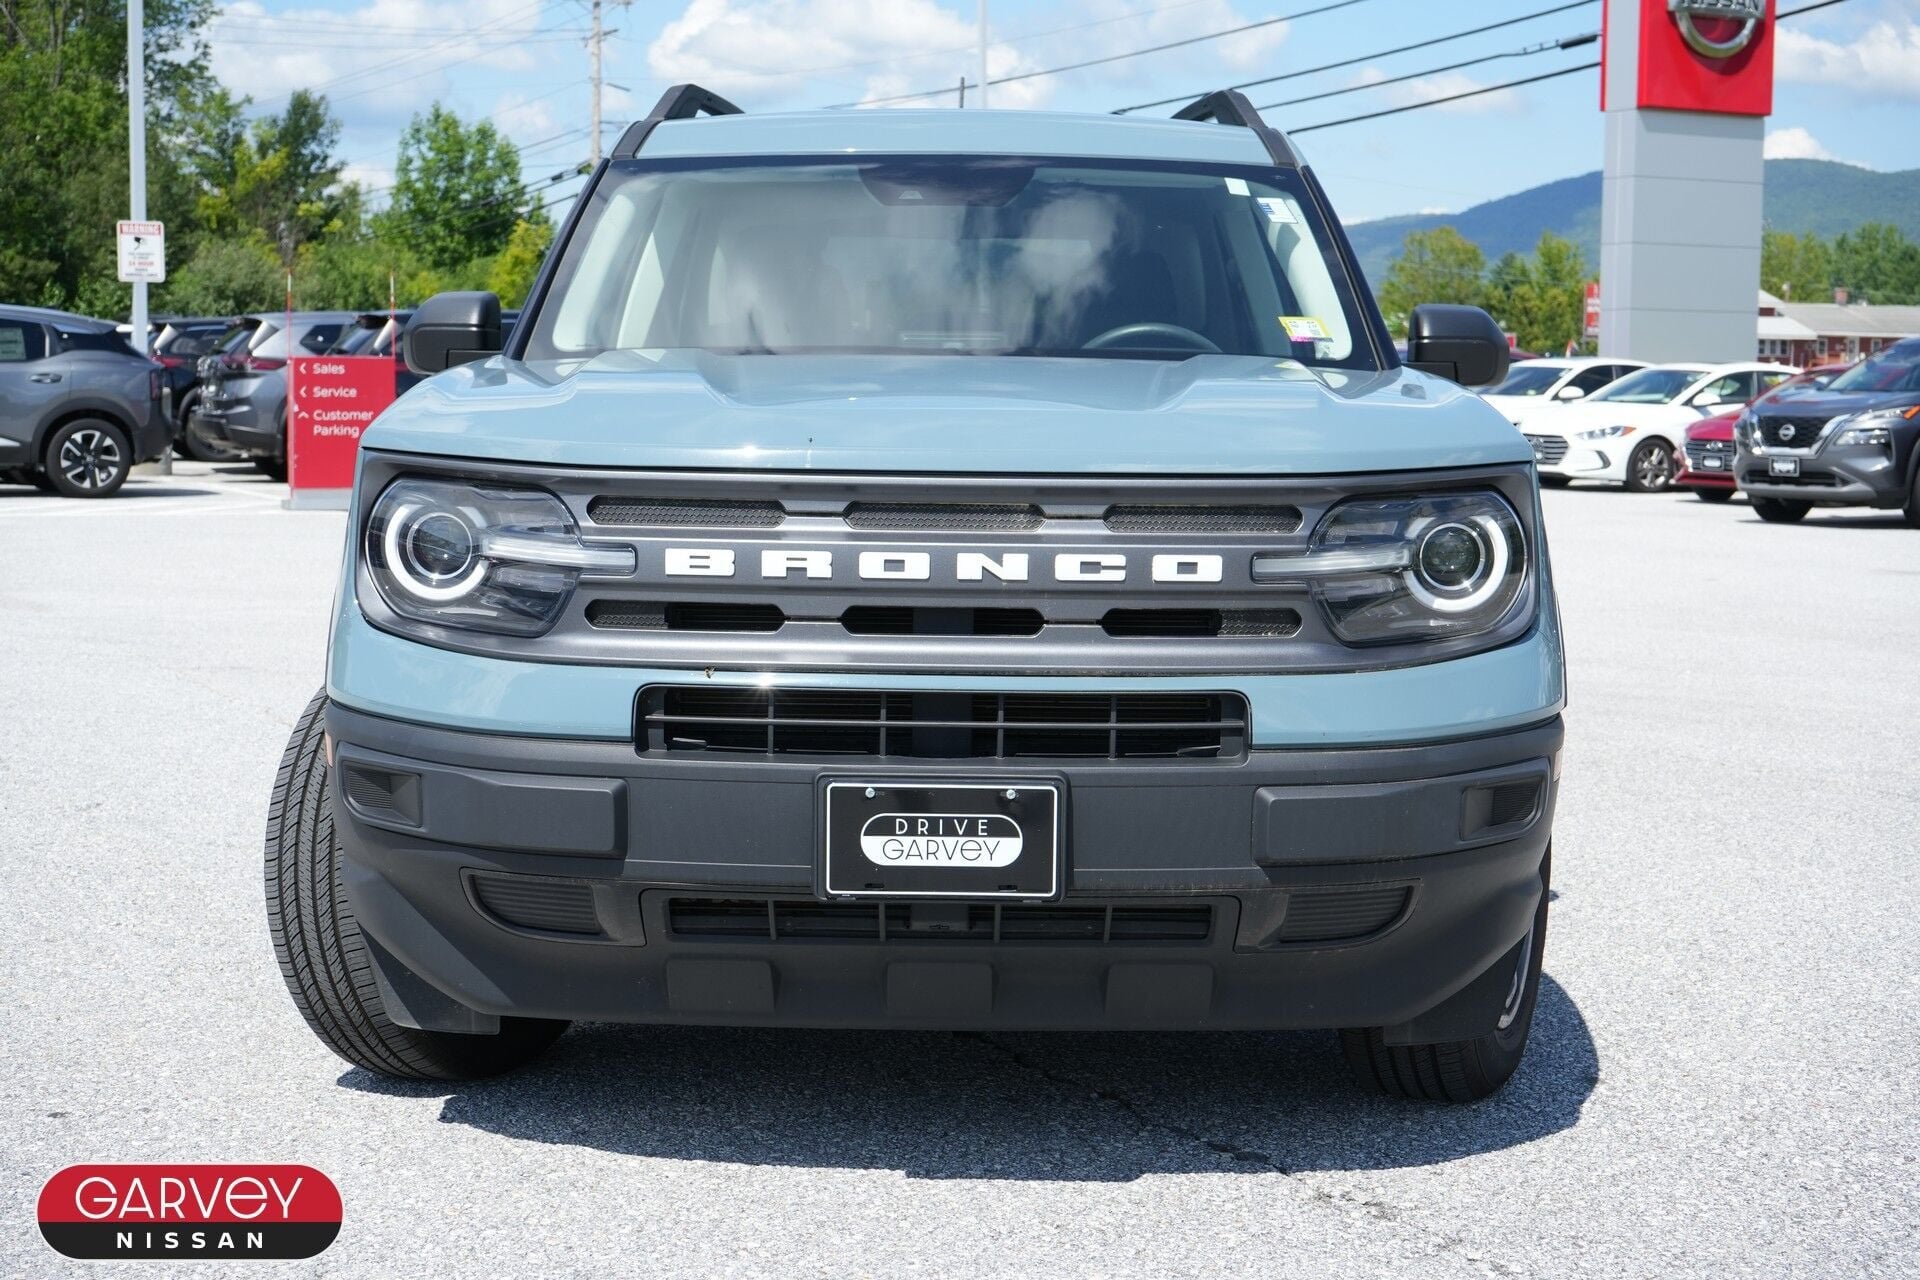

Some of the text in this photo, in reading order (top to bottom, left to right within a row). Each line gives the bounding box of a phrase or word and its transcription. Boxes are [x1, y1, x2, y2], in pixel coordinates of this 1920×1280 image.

[312, 362, 345, 375] Sales
[312, 386, 357, 398] Service
[313, 410, 374, 421] Customer
[313, 425, 360, 438] Parking
[664, 548, 1223, 582] BRONCO
[895, 818, 988, 836] DRIVE
